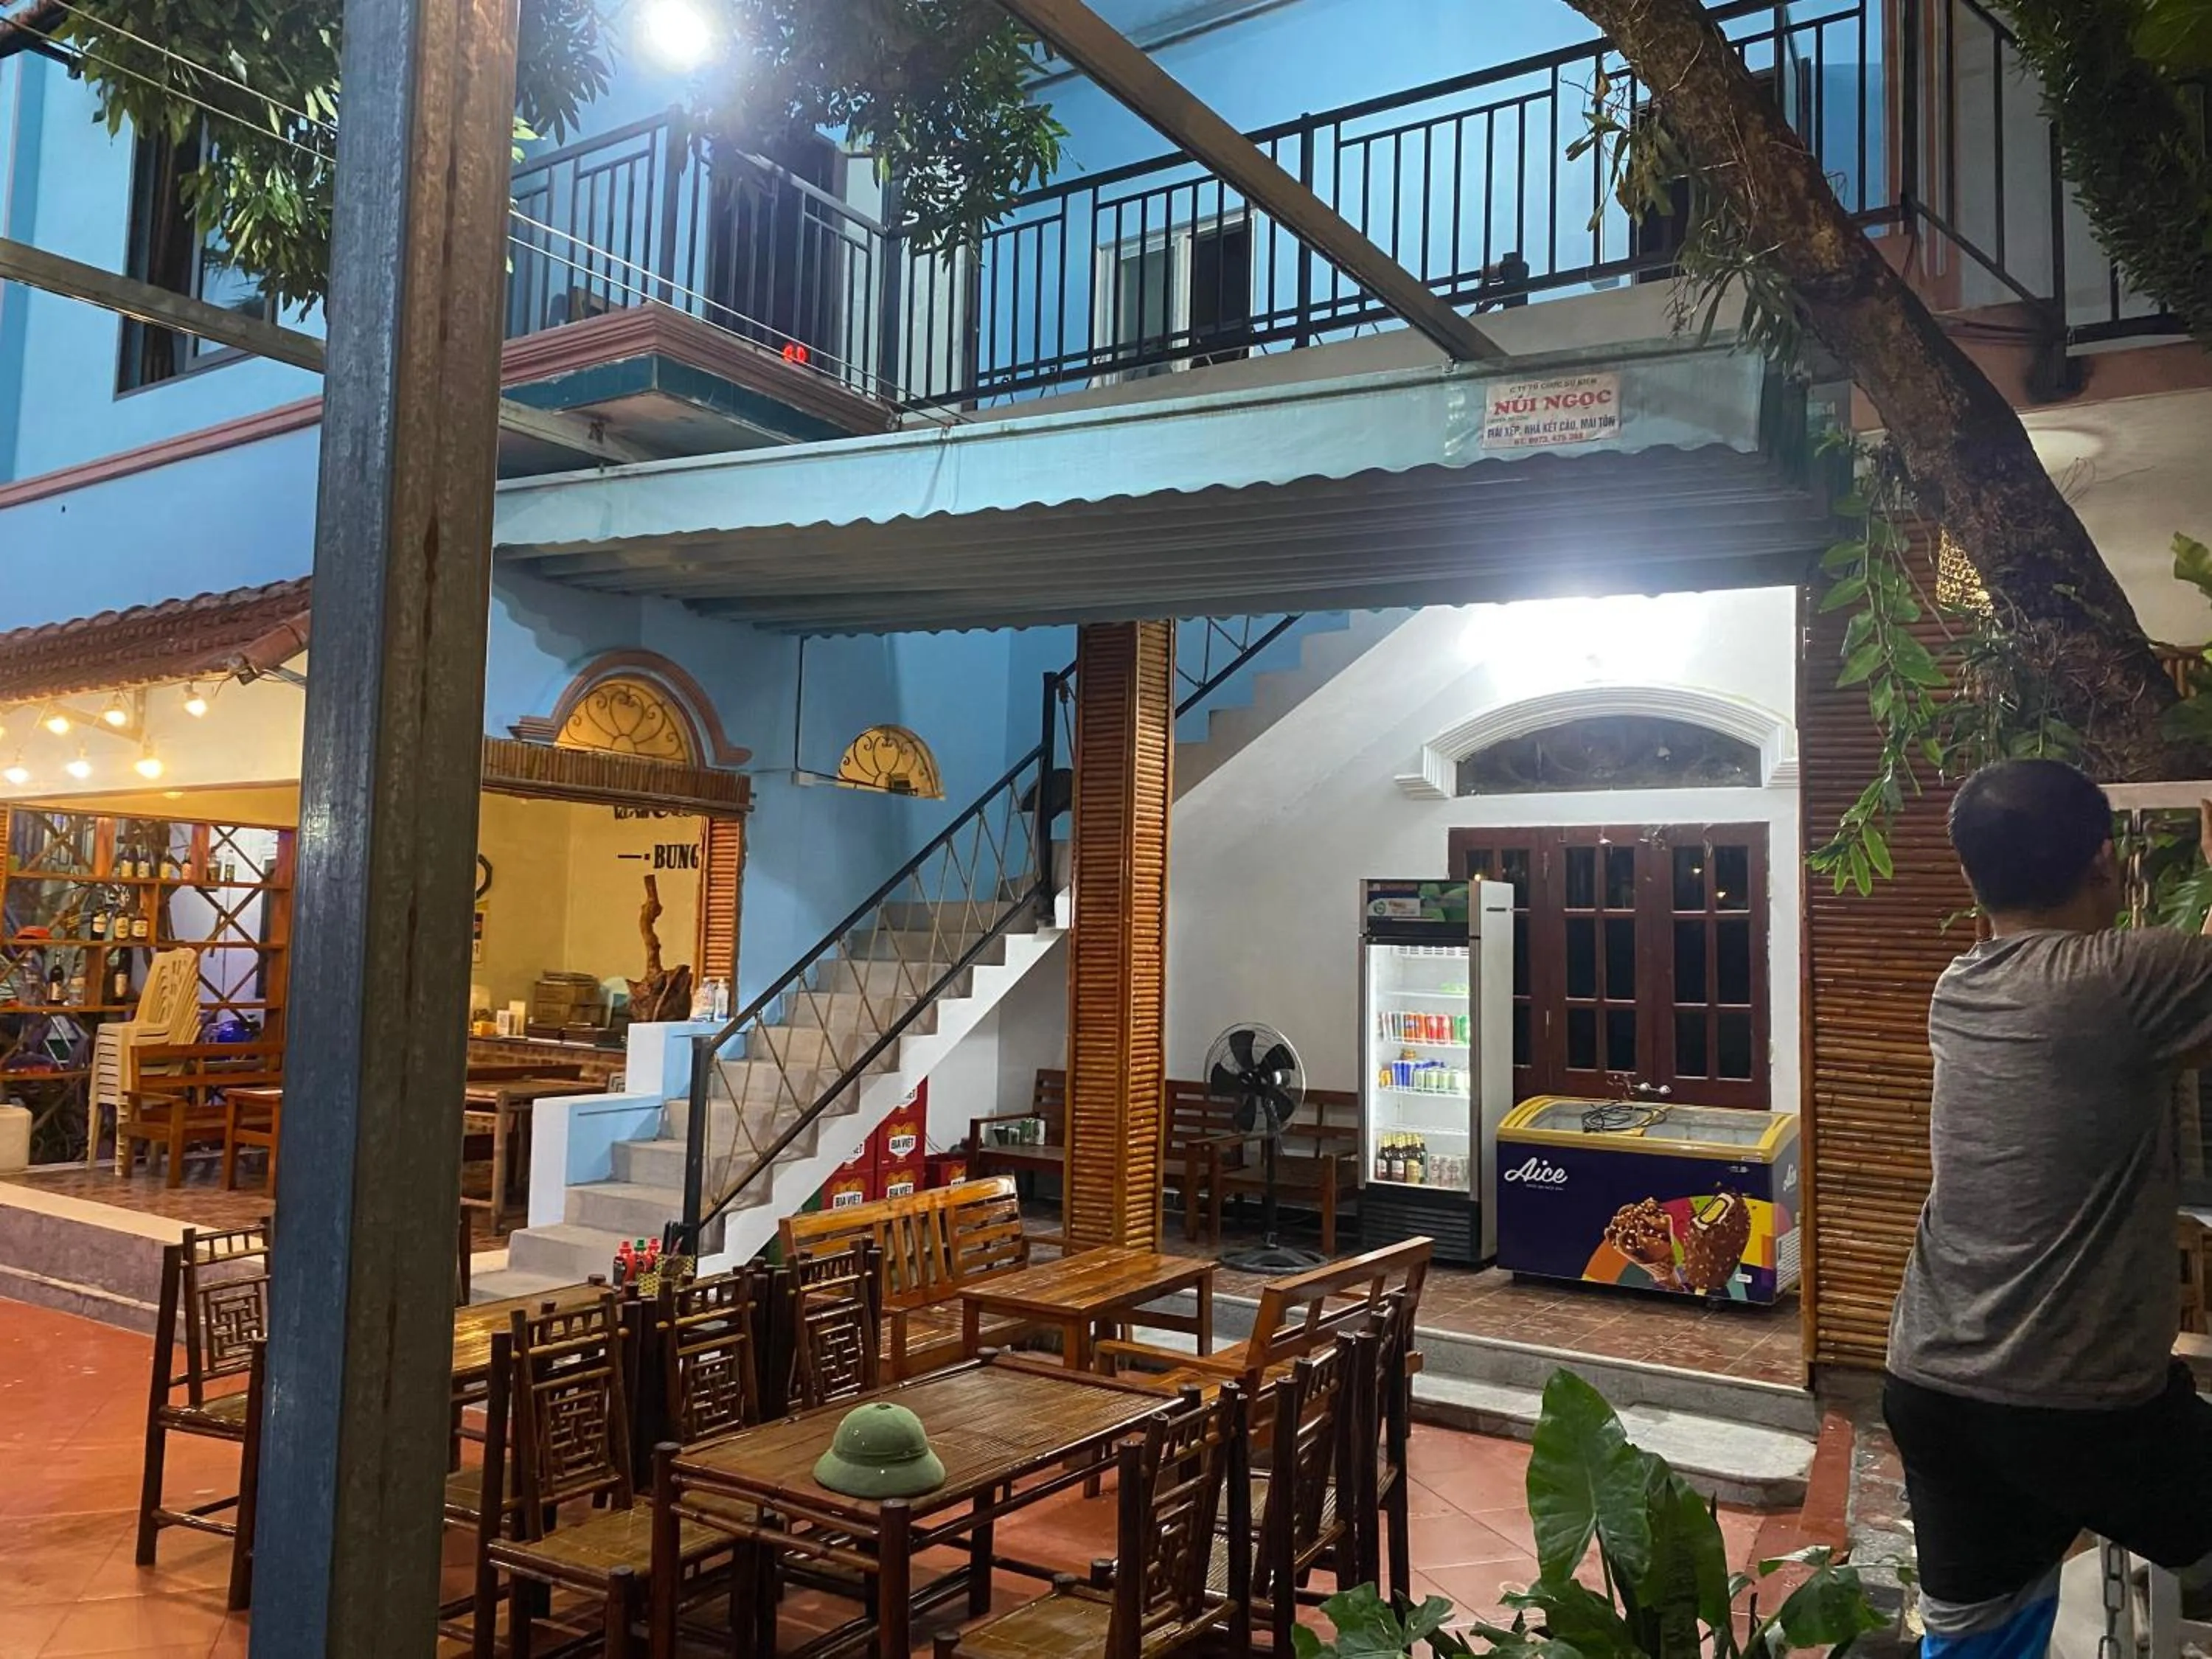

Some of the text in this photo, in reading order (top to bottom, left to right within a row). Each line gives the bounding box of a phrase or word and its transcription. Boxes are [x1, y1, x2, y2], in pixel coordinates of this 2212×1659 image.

[1494, 389, 1612, 415] NÚI NGỌC
[1504, 1157, 1568, 1183] Aice
